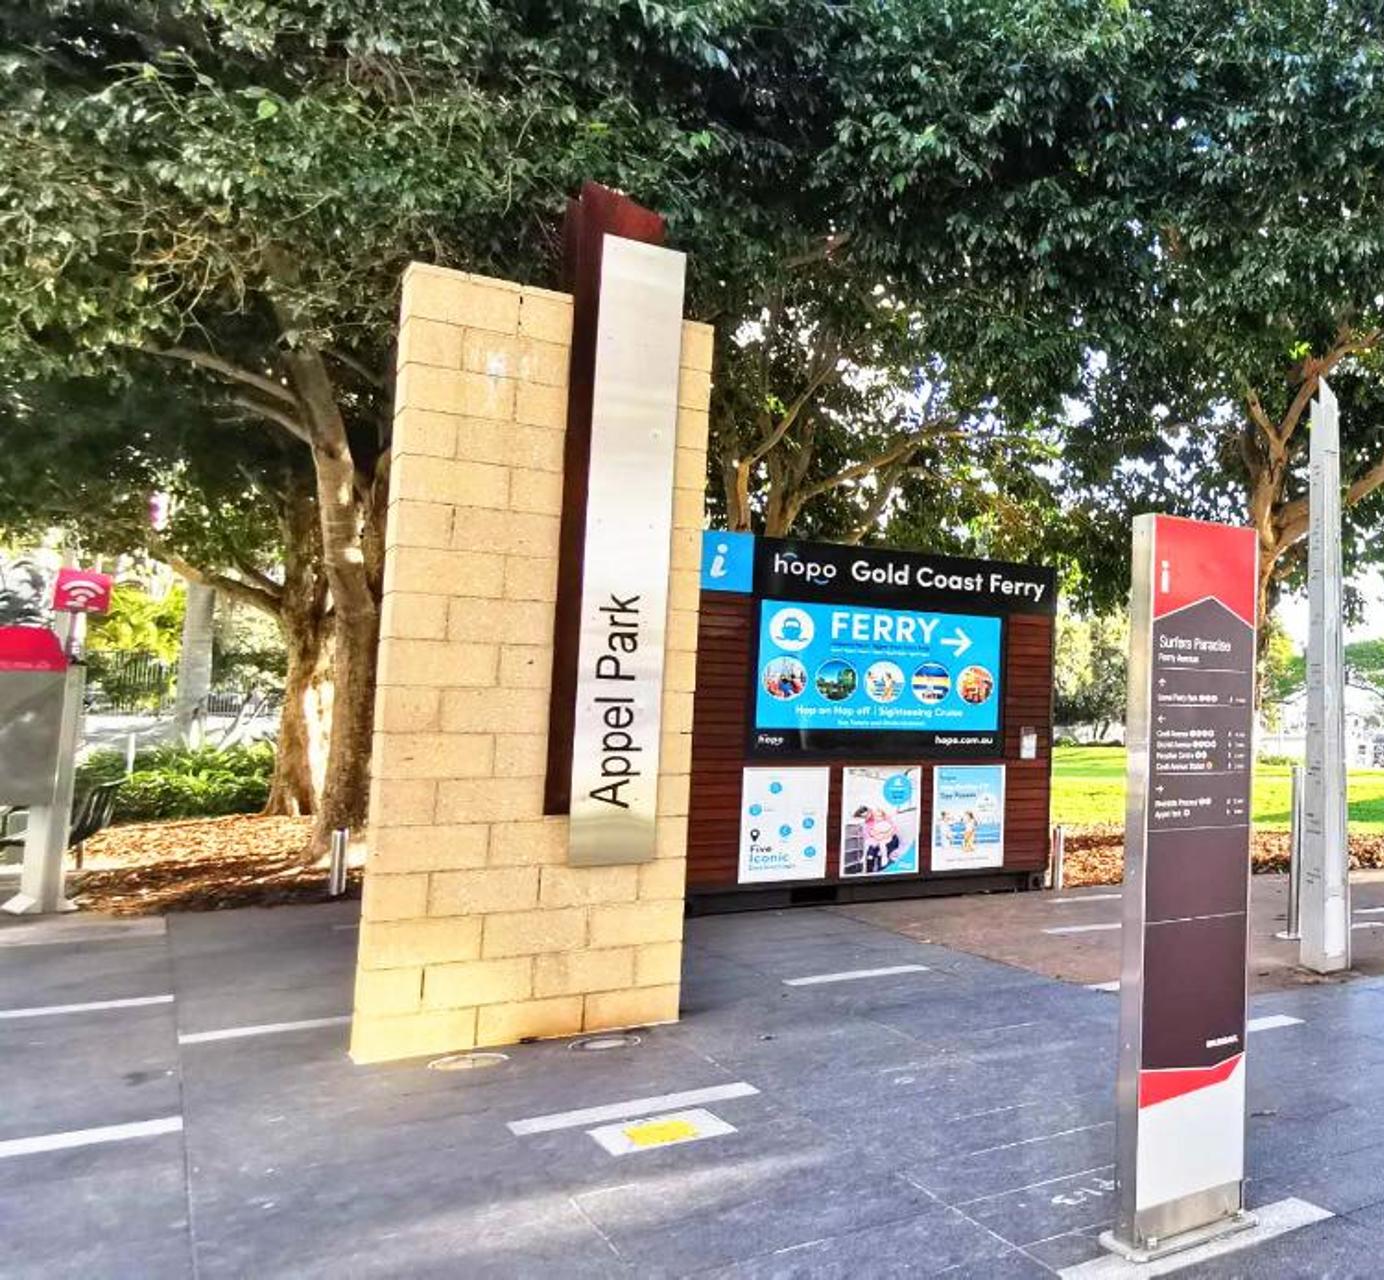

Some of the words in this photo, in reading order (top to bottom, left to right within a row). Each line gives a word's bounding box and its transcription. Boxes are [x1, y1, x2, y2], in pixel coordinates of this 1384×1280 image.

[773, 552, 837, 584] hopo
[851, 560, 910, 586] Gold
[916, 567, 983, 592] Coast
[989, 573, 1046, 602] Ferry
[595, 593, 640, 681] Park
[831, 611, 940, 645] FERRY
[1159, 634, 1192, 650] Surfers
[1193, 637, 1232, 652] Paradise
[795, 704, 817, 717] Hop
[833, 704, 854, 718] Hop
[856, 705, 871, 716] off
[877, 706, 933, 719] Sightseeing
[935, 707, 964, 718] Cruise
[934, 734, 994, 746] hopo.com.au
[589, 697, 642, 809] Appel
[749, 852, 789, 864] Iconic
[750, 845, 771, 853] Five
